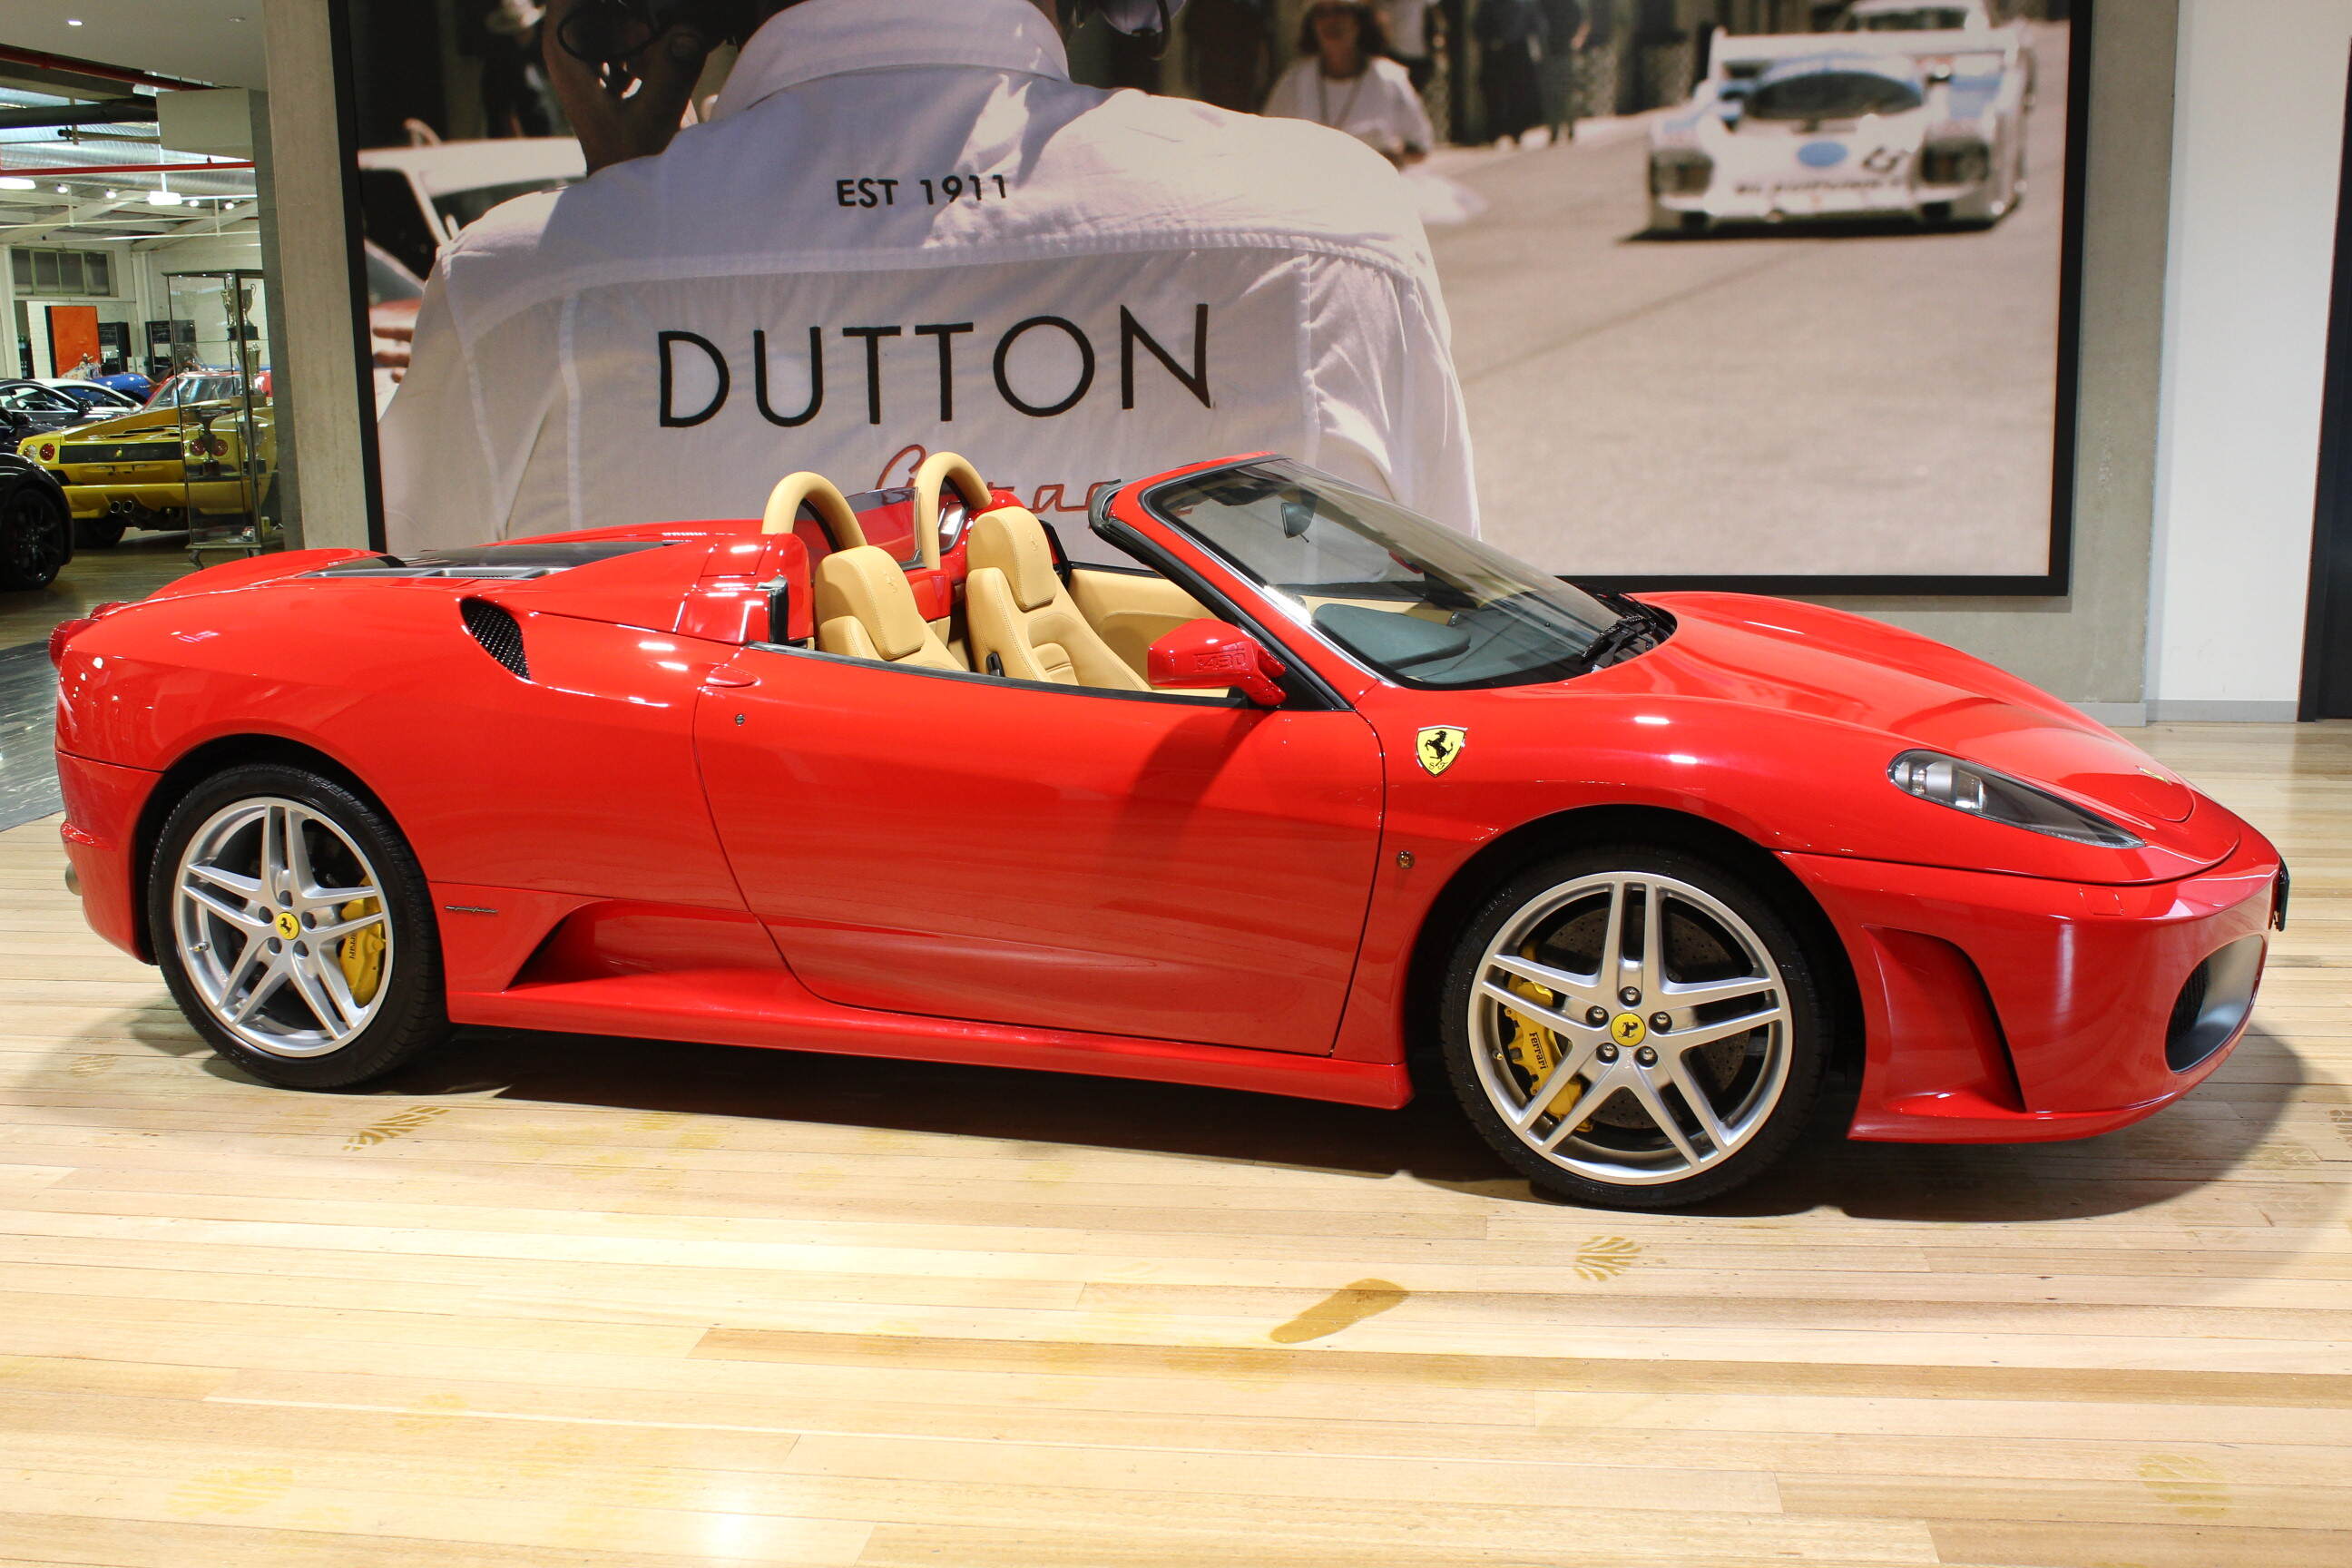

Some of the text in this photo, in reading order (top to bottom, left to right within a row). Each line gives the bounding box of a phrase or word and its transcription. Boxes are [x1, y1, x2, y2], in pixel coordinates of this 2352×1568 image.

[836, 174, 1007, 209] EST 1911
[658, 304, 1212, 427] DUTTON
[1529, 1031, 1548, 1070] Ferrari
